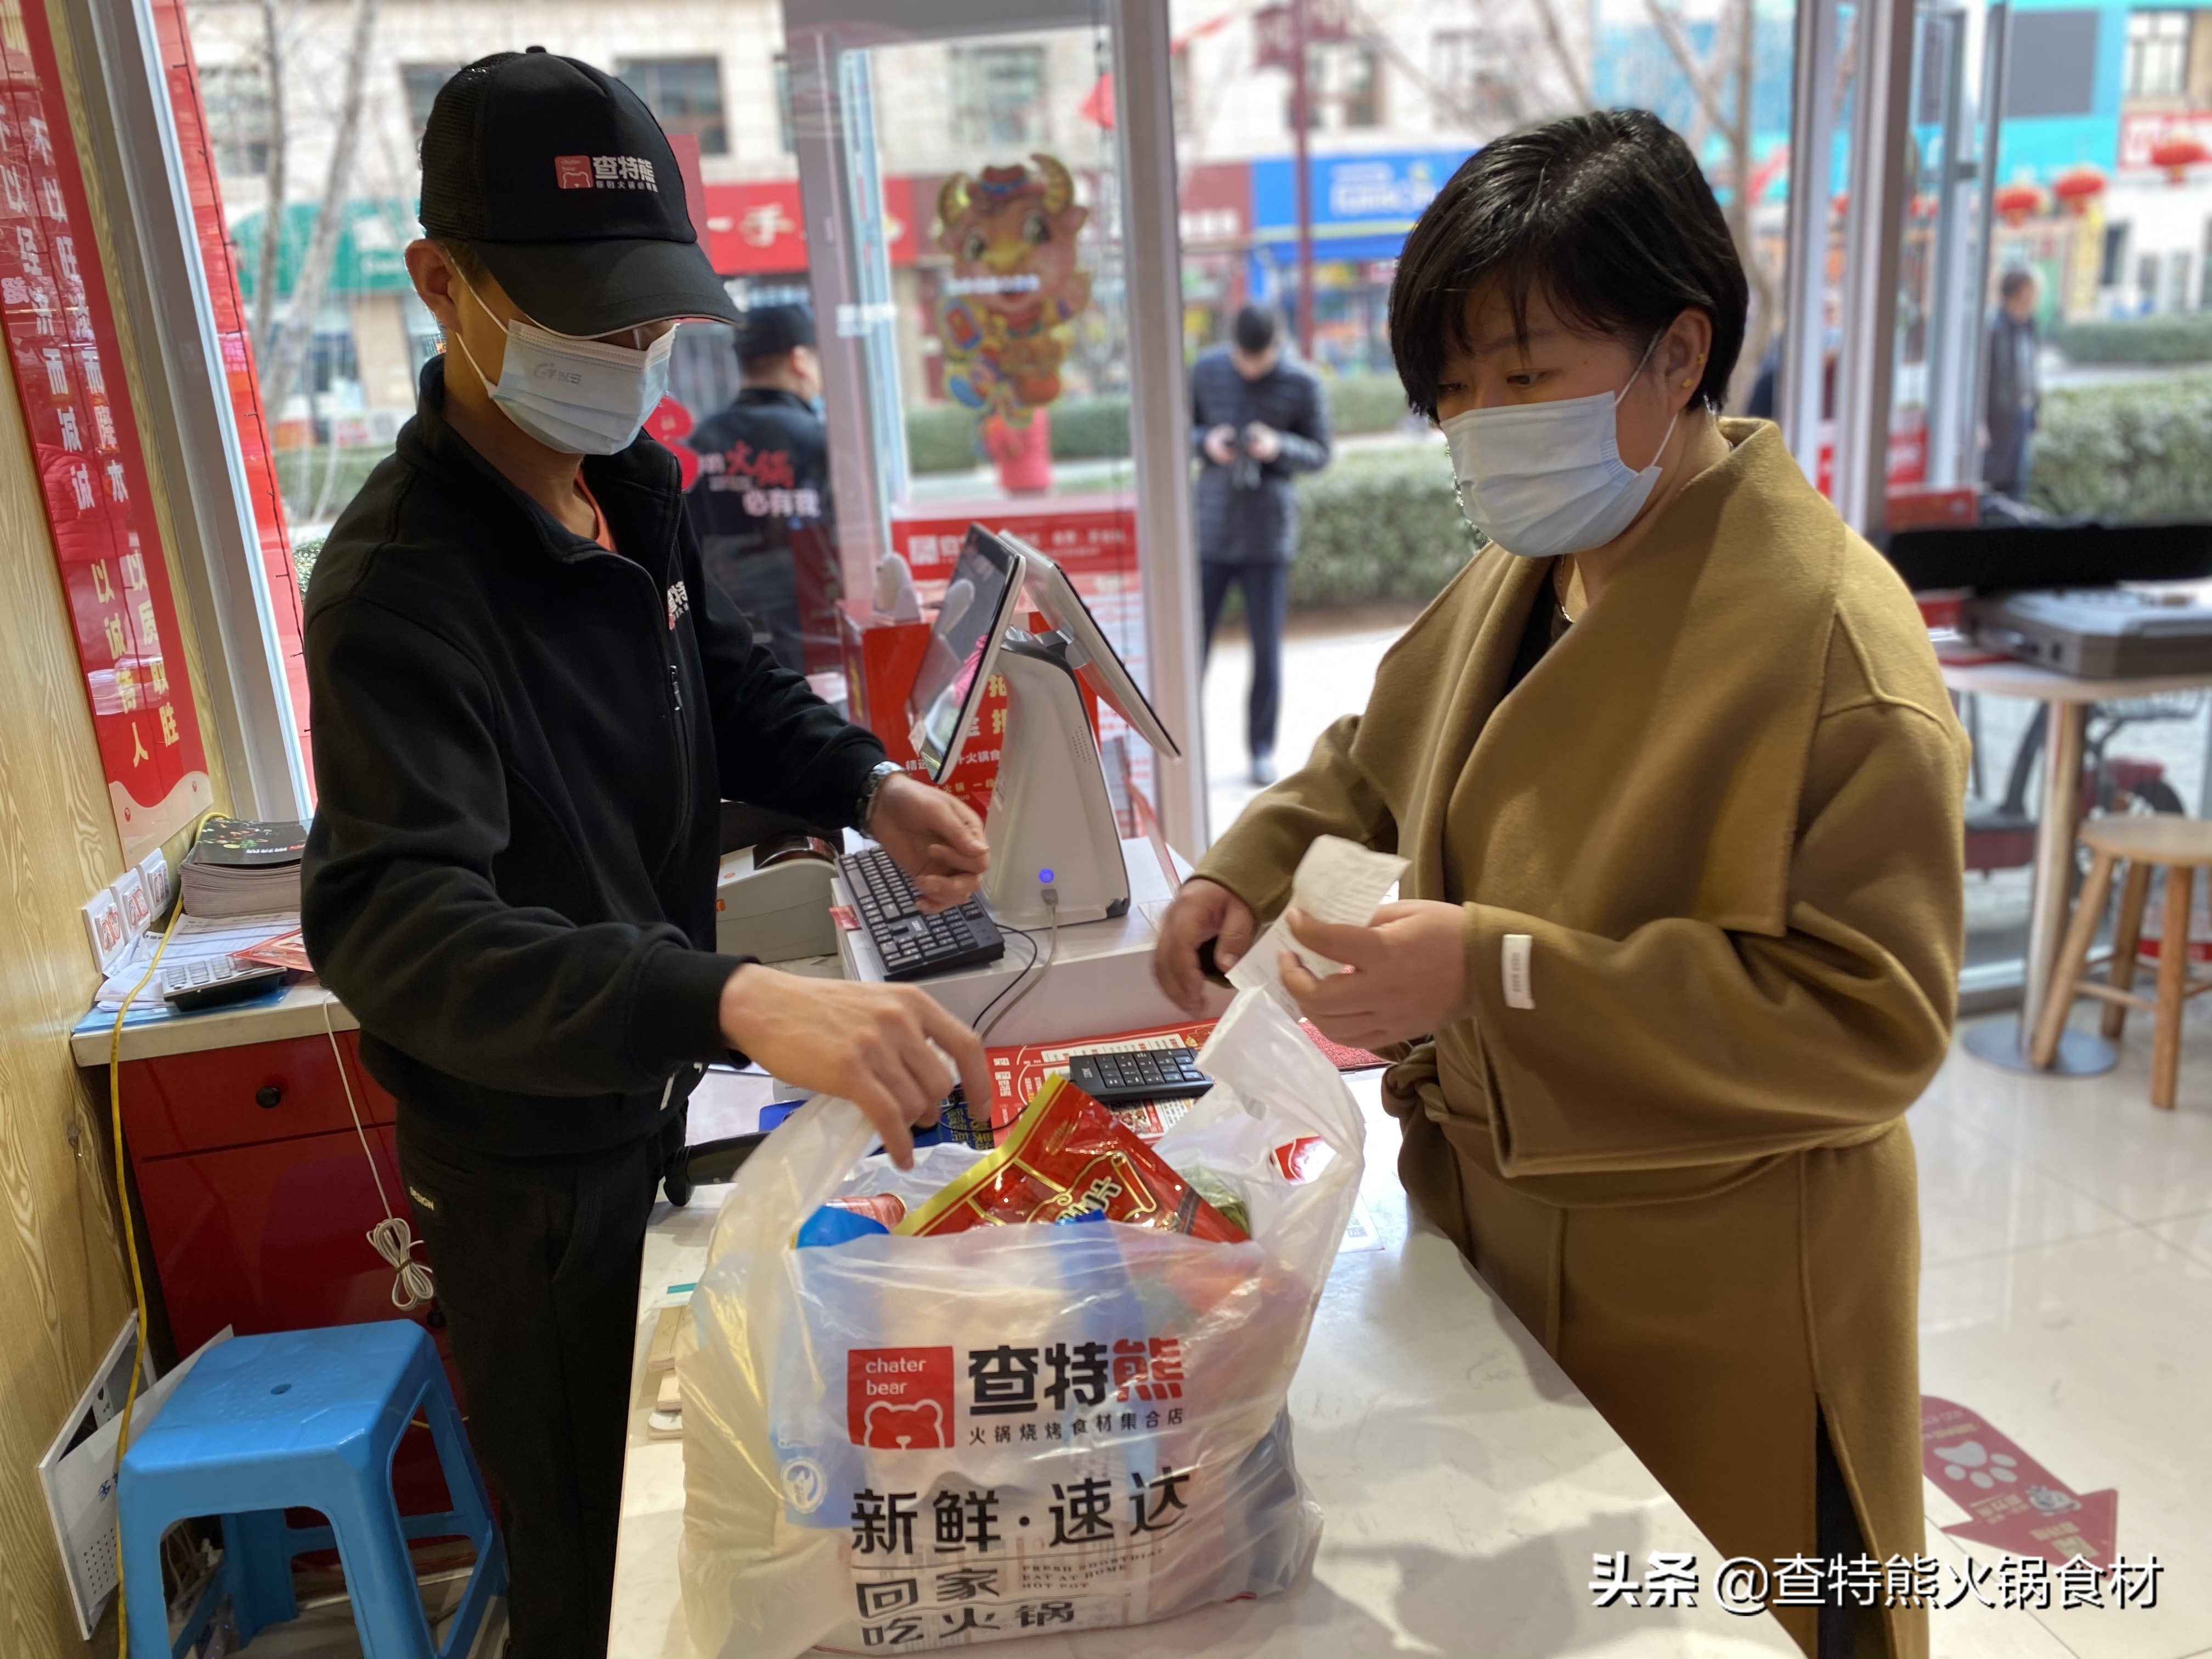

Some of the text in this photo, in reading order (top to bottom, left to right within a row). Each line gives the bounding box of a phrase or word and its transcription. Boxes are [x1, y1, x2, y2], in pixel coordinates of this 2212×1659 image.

[592, 155, 656, 184] 查特熊
[91, 558, 149, 768] 以诚待人
[865, 1356, 927, 1374] chater
[968, 1338, 1184, 1415] 查特熊
[866, 1379, 908, 1396] bear
[969, 1408, 1183, 1446] 火锅烧烤食材集合店
[856, 1568, 1000, 1618] 回家
[862, 1602, 1075, 1646] 吃火锅
